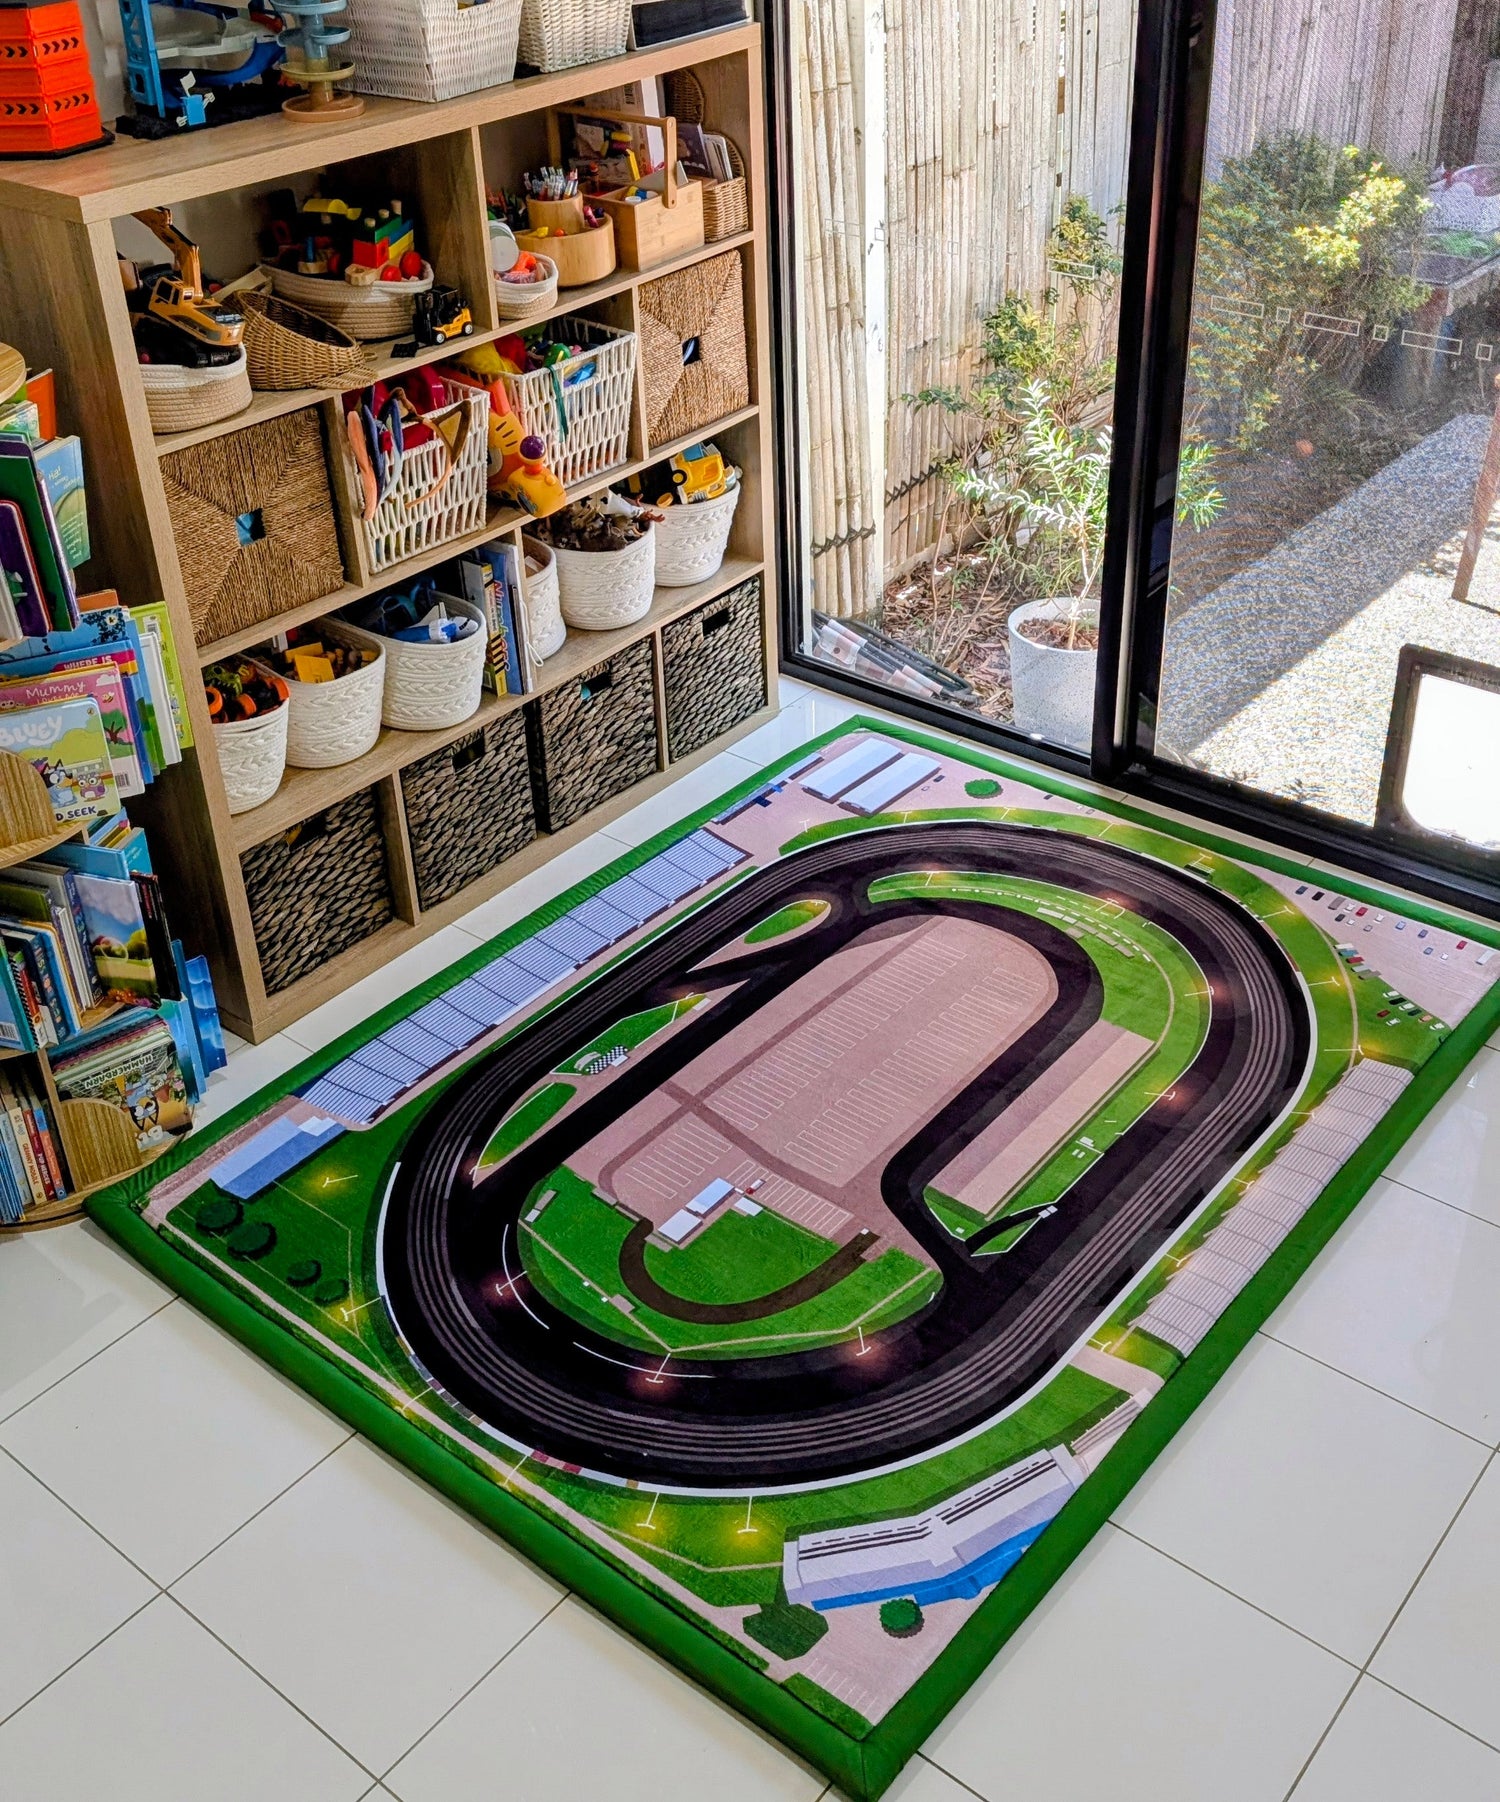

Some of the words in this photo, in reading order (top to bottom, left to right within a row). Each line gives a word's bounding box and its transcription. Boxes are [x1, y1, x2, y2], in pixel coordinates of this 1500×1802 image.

[26, 681, 86, 698] Mummy
[0, 715, 62, 746] BLUEY
[67, 805, 97, 819] SEEK
[84, 1053, 154, 1090] HAMMERBARN
